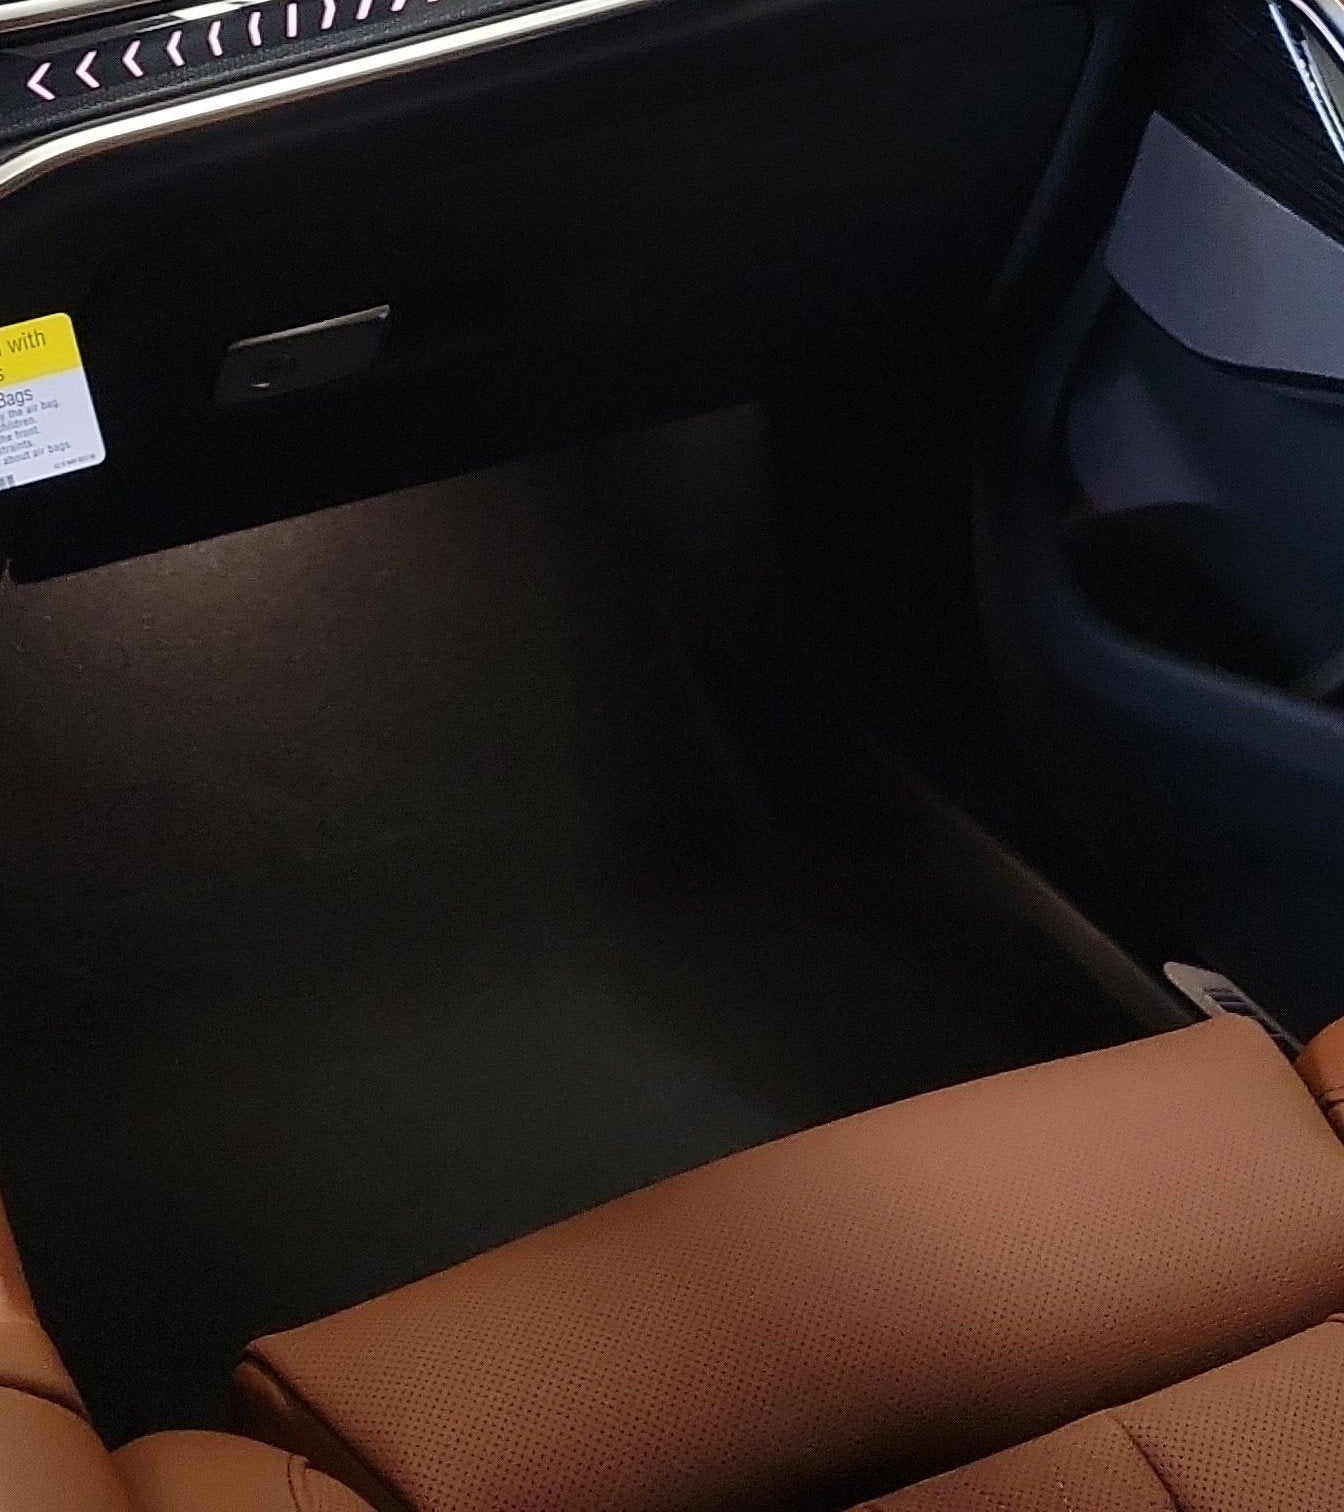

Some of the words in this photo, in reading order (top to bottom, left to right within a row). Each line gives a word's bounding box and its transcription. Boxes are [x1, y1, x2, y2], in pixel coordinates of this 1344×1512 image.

[7, 329, 45, 352] with
[7, 408, 23, 418] the
[26, 404, 37, 414] air
[3, 451, 30, 464] about
[32, 448, 44, 457] air
